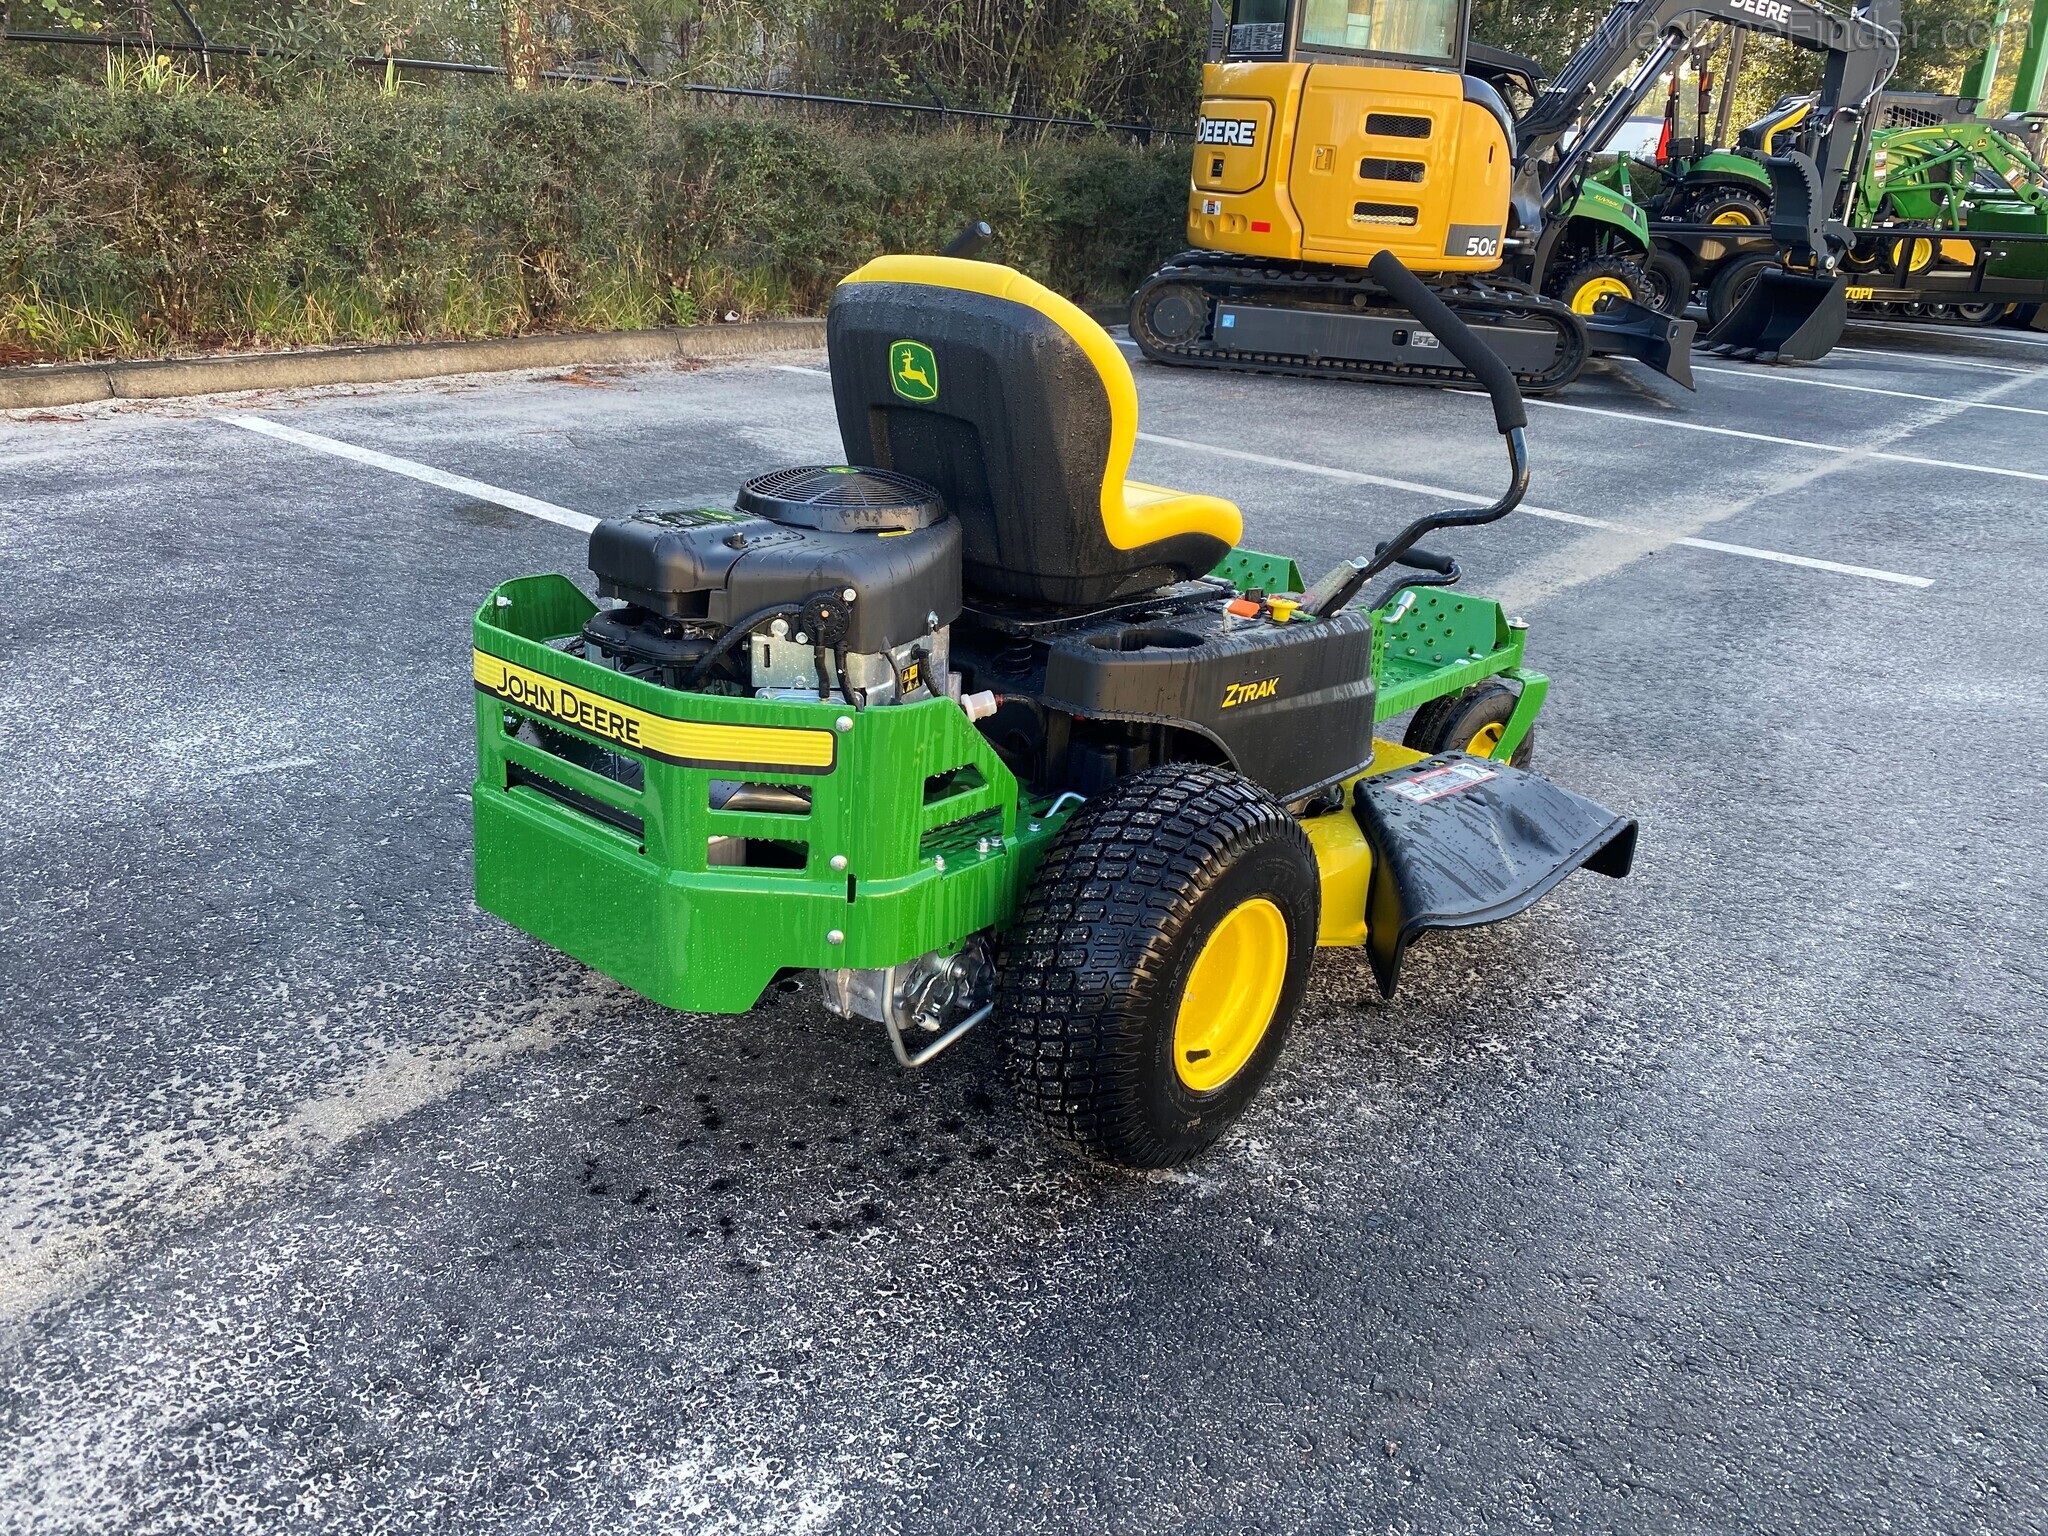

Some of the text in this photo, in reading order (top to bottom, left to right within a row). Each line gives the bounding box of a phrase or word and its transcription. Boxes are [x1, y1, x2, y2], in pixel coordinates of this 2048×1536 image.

[1197, 115, 1256, 146] DEERE
[1466, 236, 1497, 256] 50G
[496, 667, 641, 745] JOHN DEERE
[1221, 677, 1280, 708] ZTRAK
